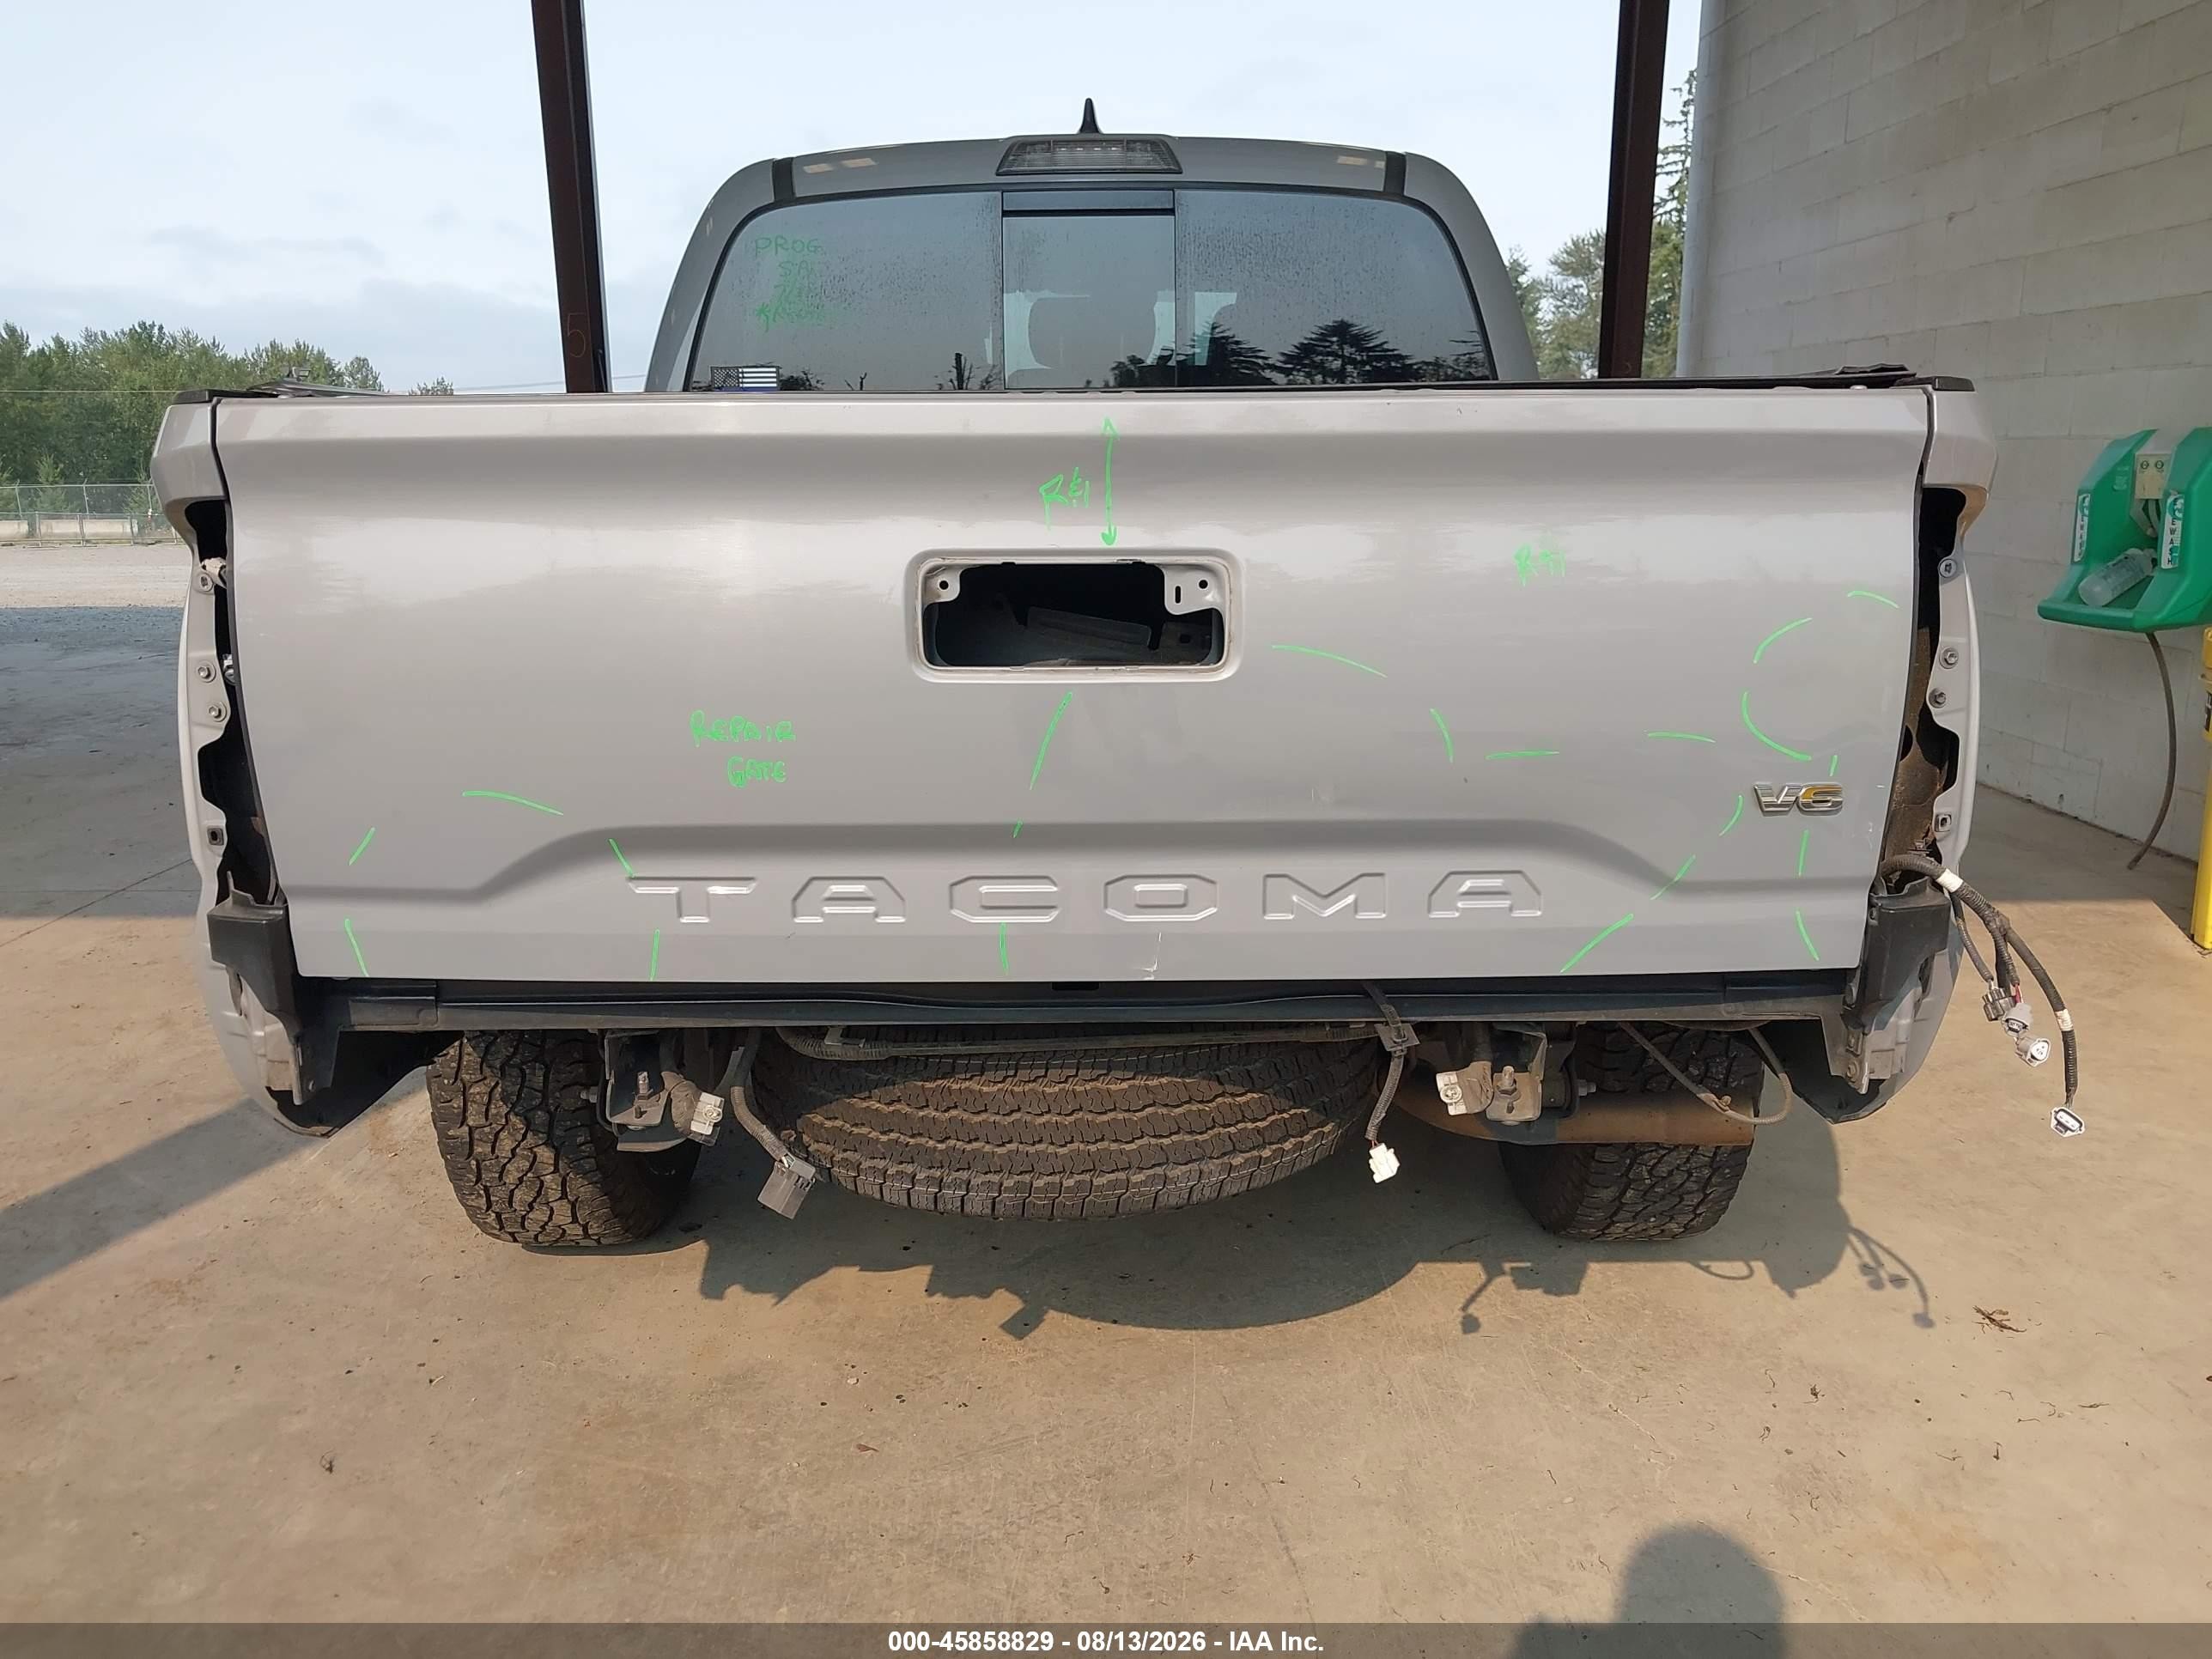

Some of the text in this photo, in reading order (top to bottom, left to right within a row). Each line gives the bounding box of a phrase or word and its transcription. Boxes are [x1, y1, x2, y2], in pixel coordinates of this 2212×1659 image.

[755, 234, 822, 258] PROG
[567, 313, 586, 358] 5
[1753, 781, 1844, 817] V6
[625, 871, 1542, 923] TACOMA
